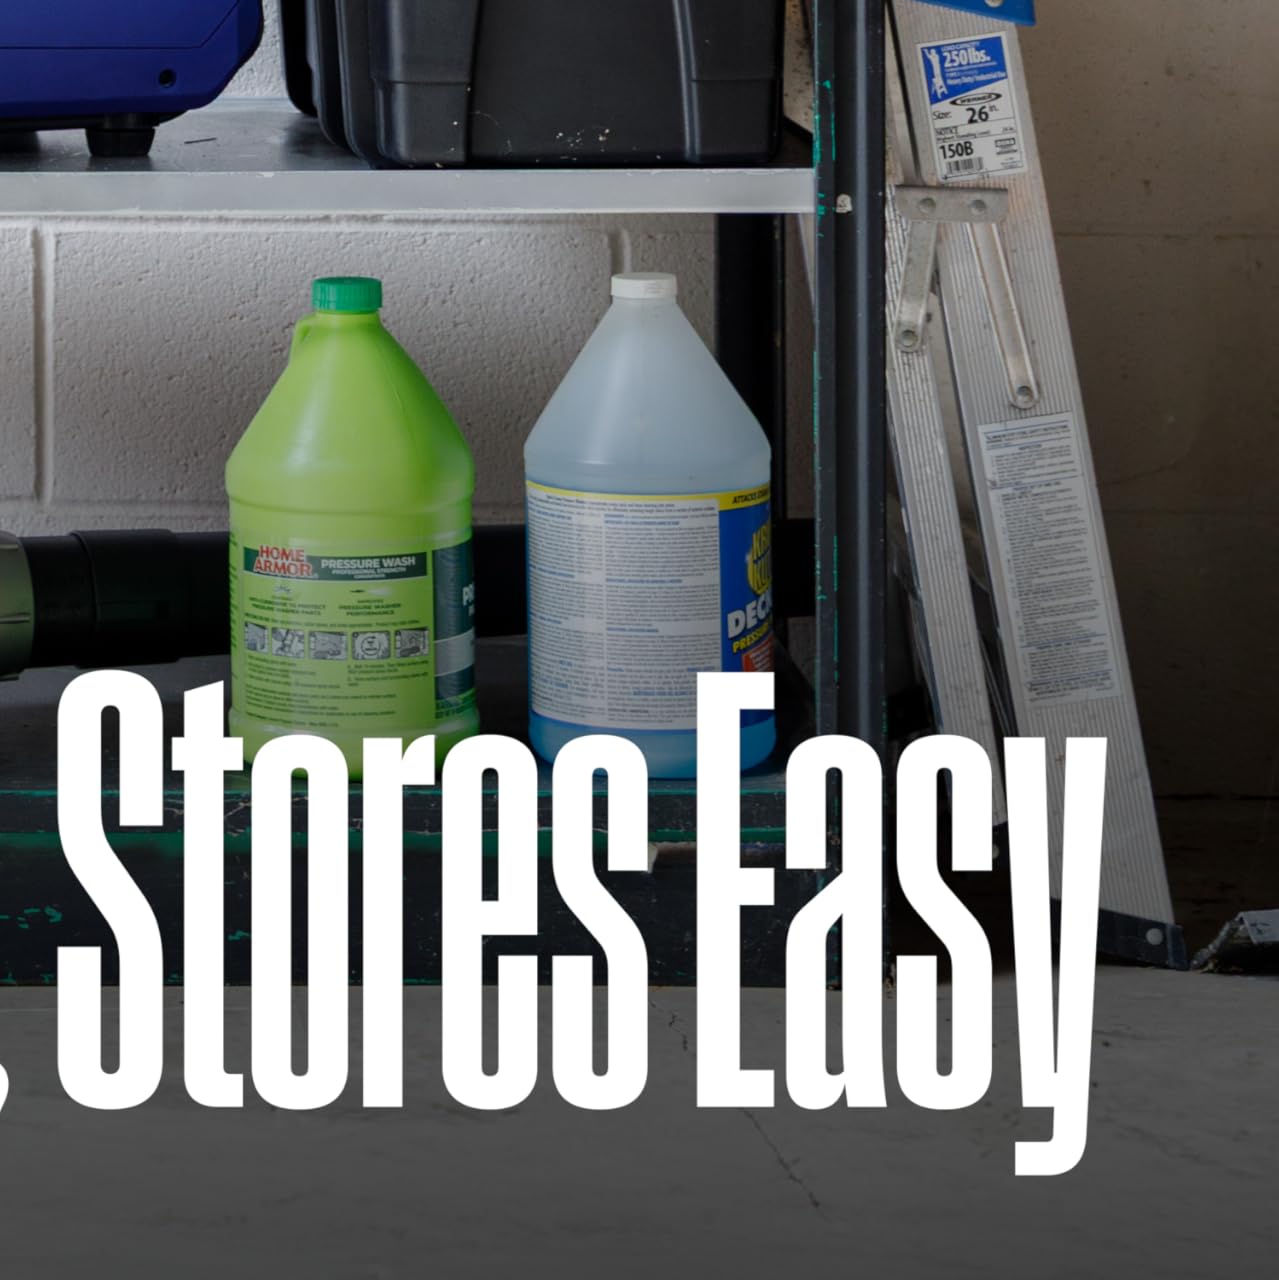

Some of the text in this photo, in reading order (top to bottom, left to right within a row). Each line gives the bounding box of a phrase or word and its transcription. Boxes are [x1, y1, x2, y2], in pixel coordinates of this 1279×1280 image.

[966, 105, 989, 124] 26
[939, 140, 974, 159] 150B
[259, 545, 305, 562] HOME
[253, 559, 314, 576] ARMOR
[321, 556, 416, 569] PRESSURE WASH
